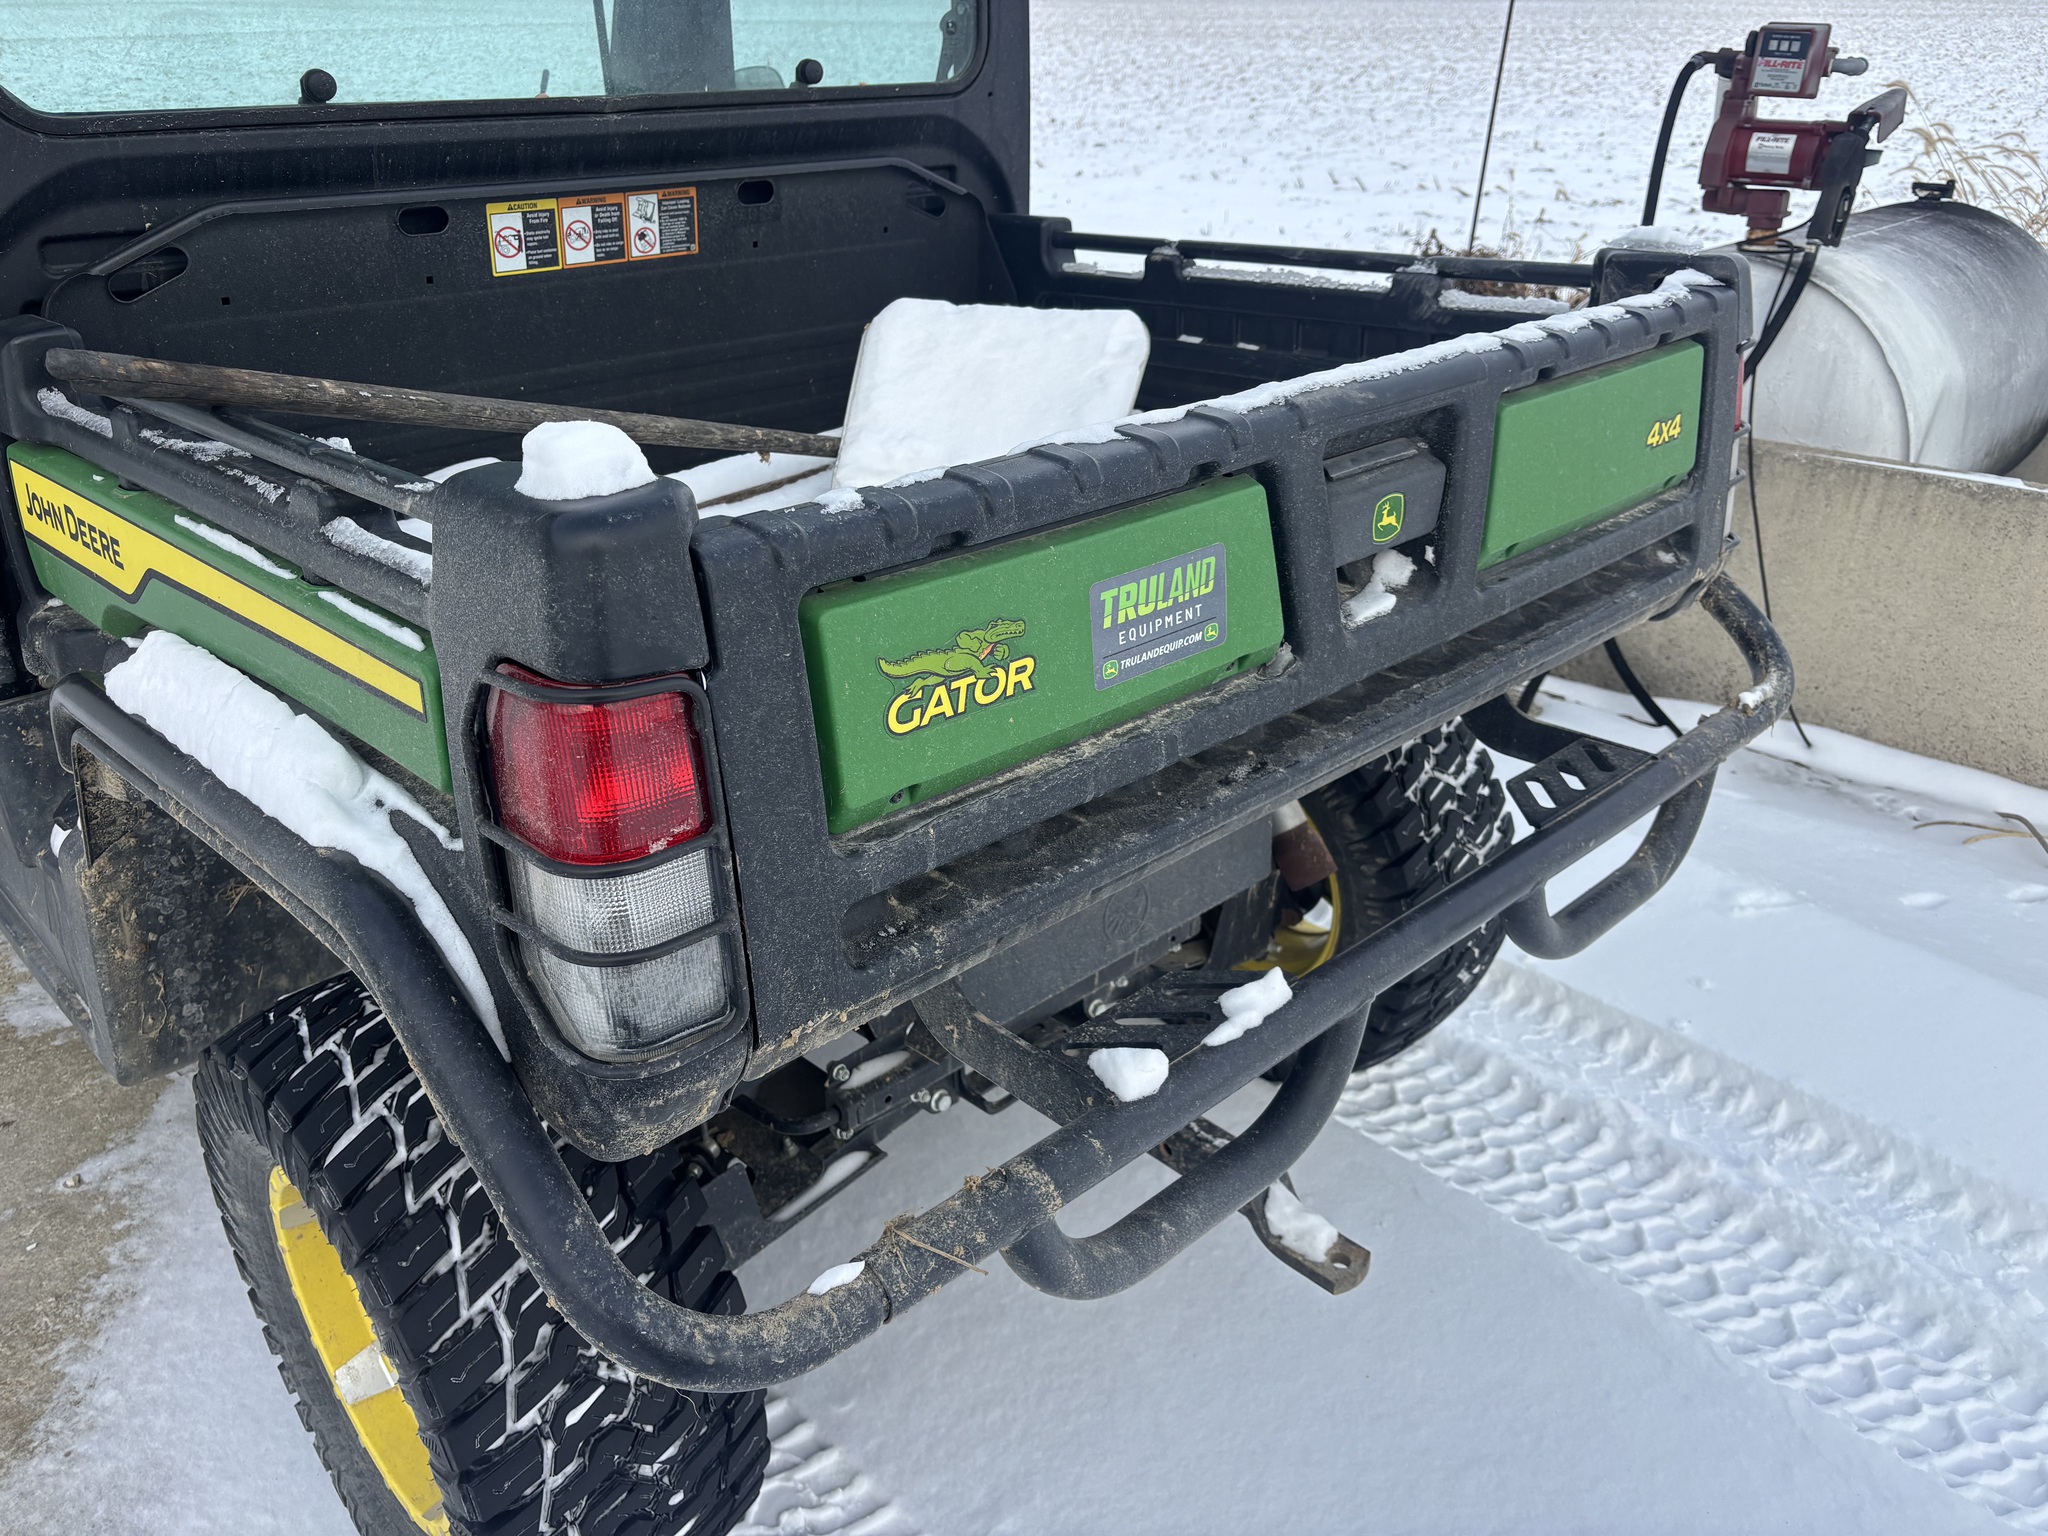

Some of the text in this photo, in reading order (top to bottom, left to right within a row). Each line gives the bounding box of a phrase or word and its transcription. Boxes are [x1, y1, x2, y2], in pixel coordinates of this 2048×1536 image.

[513, 202, 538, 211] CAUTION
[581, 196, 607, 204] WARNING
[25, 482, 125, 571] JOHN DEERE
[1100, 556, 1217, 630] TRULAND
[1118, 603, 1202, 646] EQUIPMENT
[1120, 631, 1203, 670] TRULANDEQUIP.COM
[886, 655, 1036, 736] GATOR
